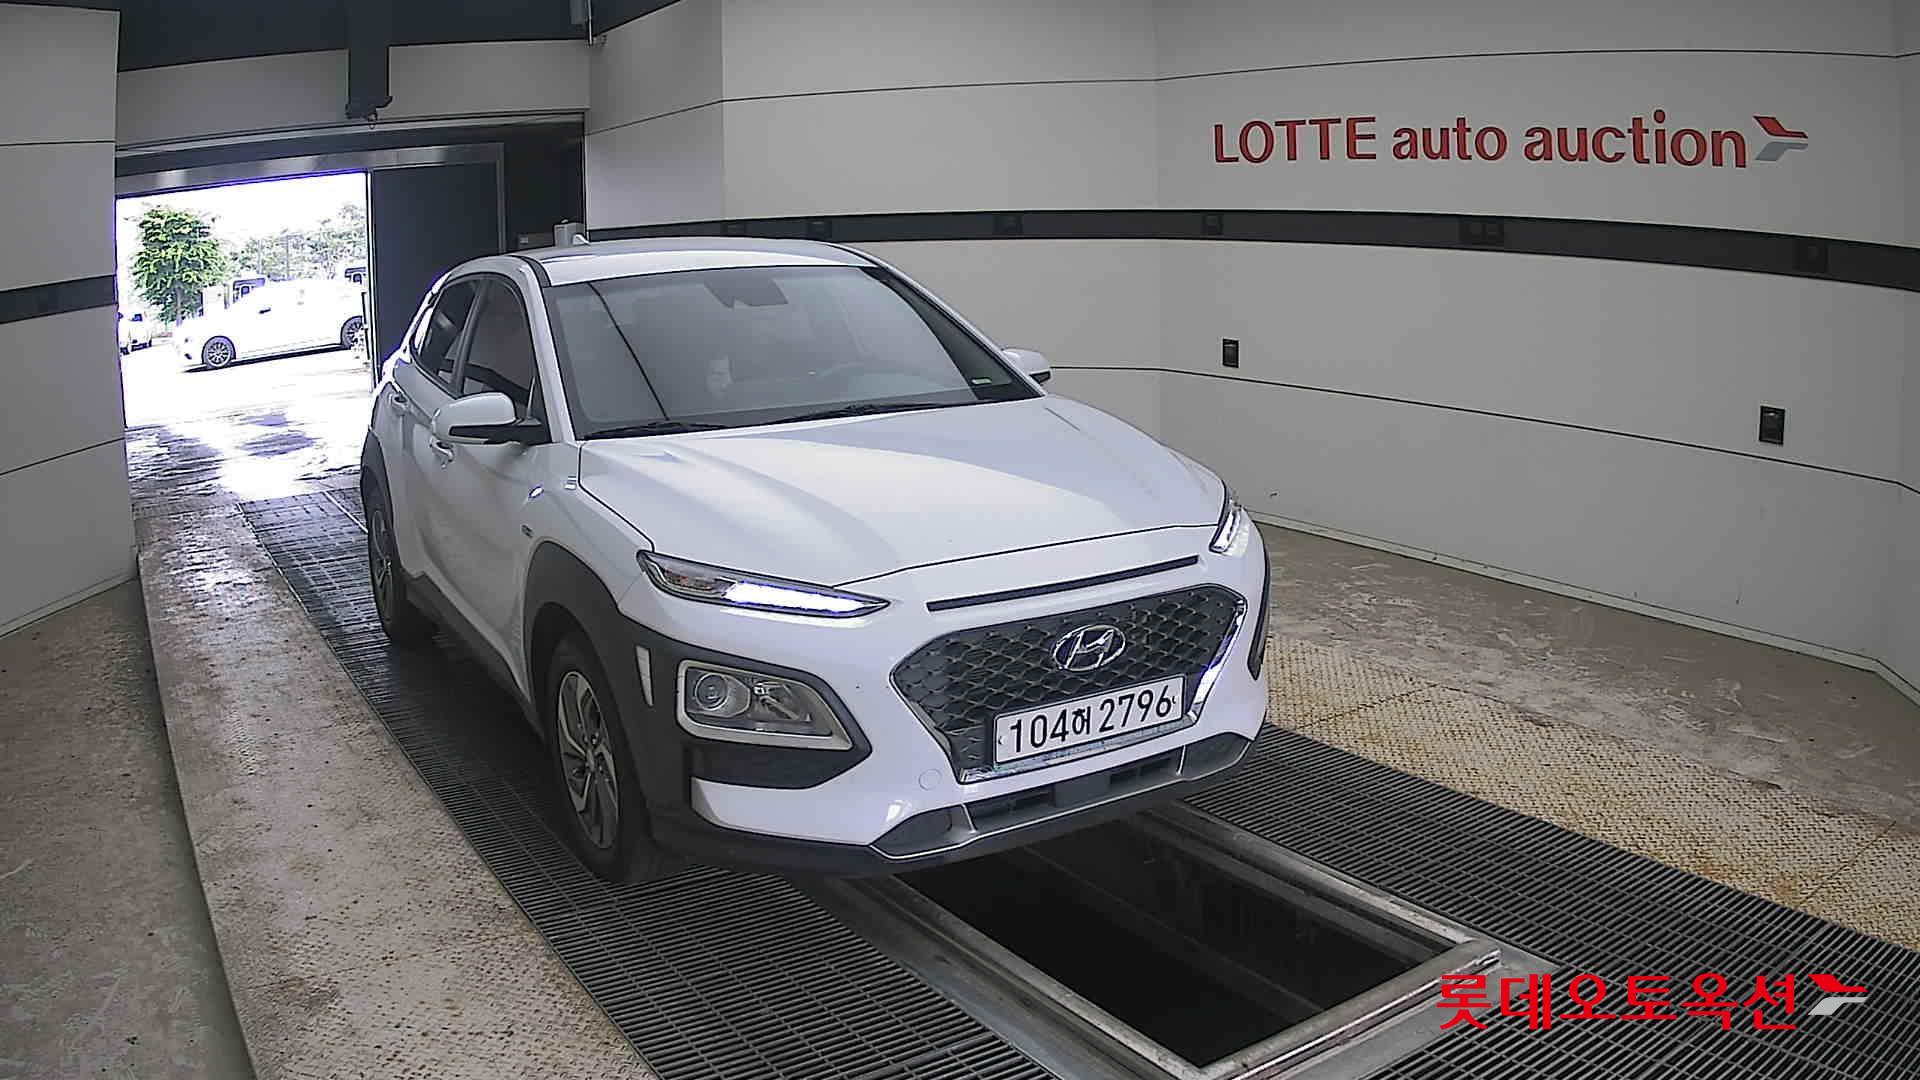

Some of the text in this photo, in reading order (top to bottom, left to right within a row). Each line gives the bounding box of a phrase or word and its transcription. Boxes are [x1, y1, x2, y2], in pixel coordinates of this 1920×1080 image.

[1213, 108, 1747, 169] LOTTE auto auction
[1009, 684, 1170, 753] 104허 2796
